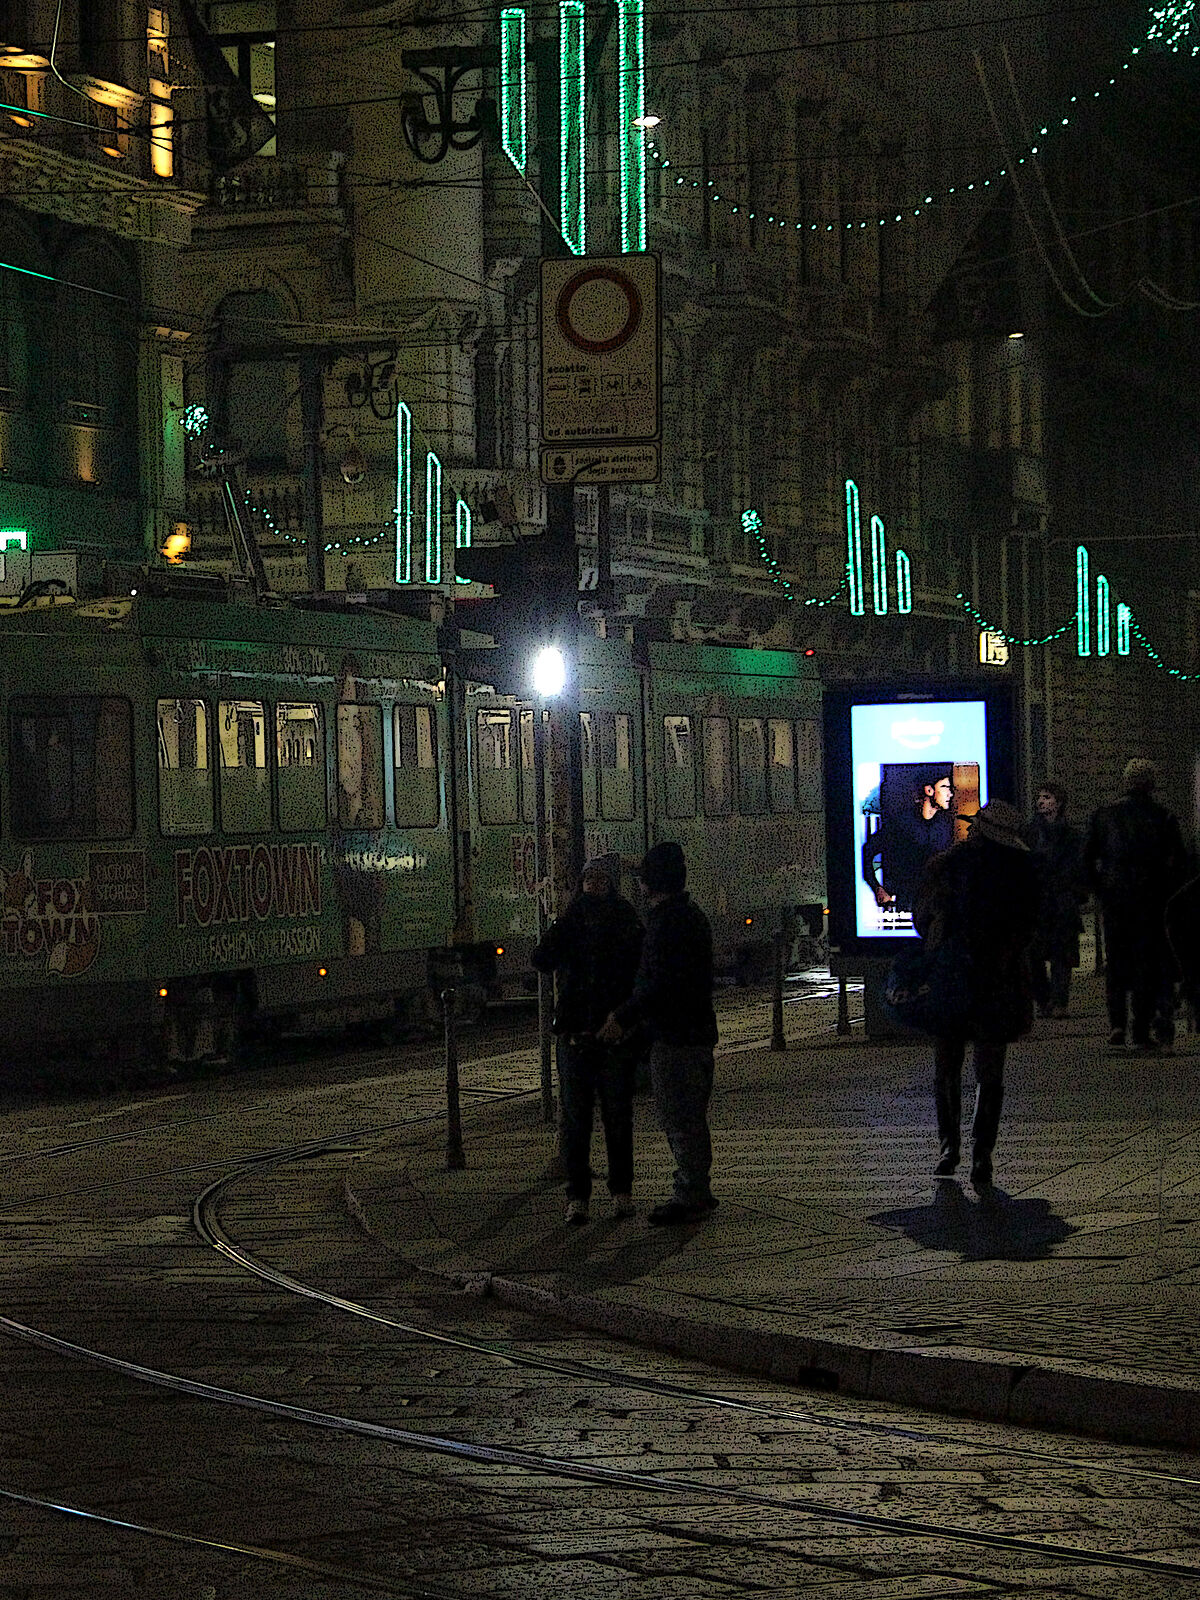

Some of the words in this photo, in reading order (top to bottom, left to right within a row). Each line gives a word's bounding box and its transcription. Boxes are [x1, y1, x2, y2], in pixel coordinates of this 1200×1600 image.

[565, 425, 619, 436] autorizzati
[173, 842, 323, 929] FOXTOWN
[1, 916, 99, 956] TOWN
